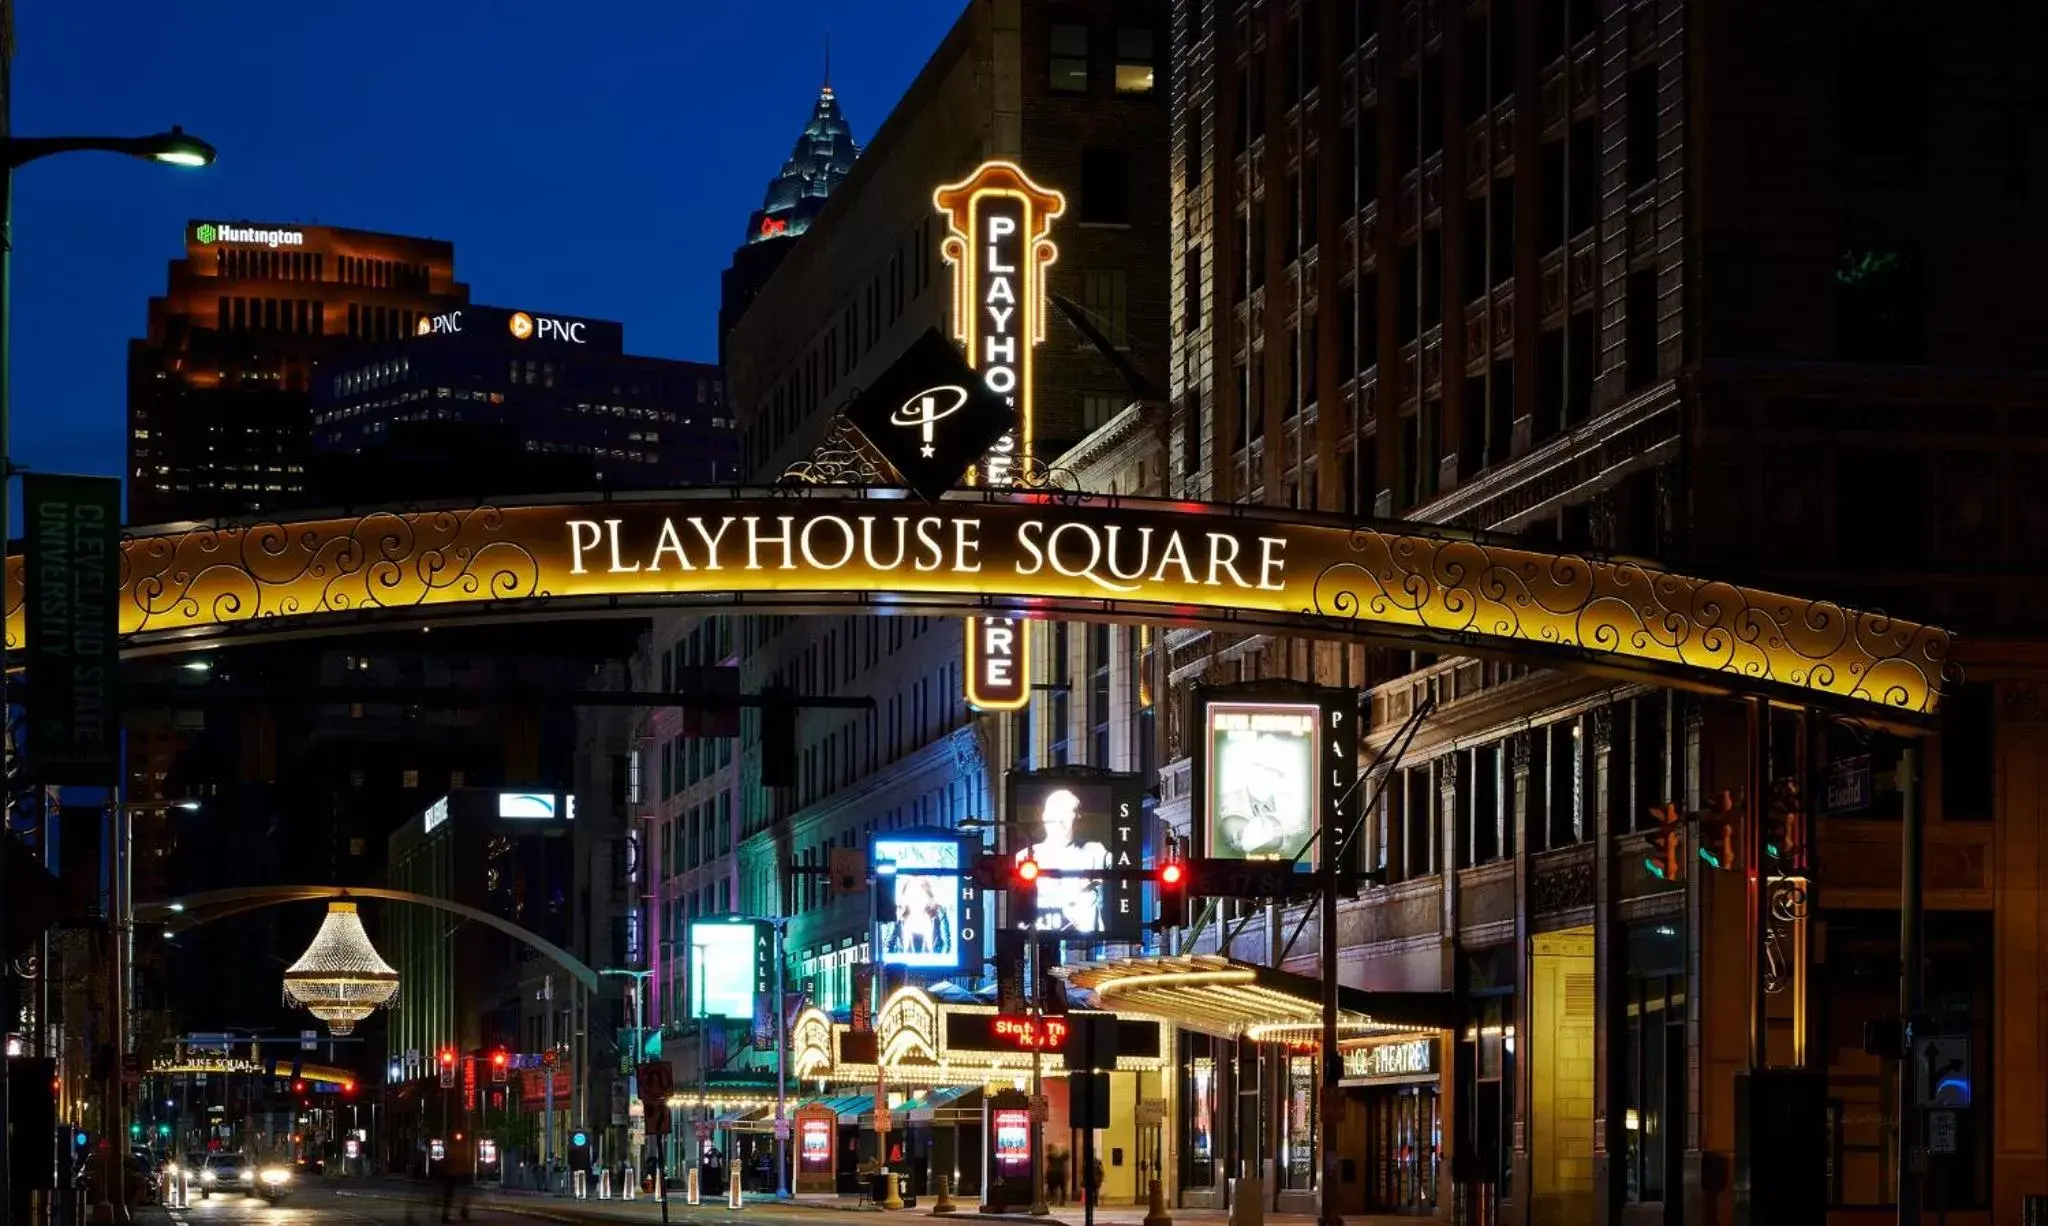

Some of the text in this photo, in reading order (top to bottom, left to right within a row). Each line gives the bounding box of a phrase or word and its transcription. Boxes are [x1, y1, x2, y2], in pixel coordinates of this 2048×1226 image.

[218, 225, 303, 248] Huntington
[432, 310, 462, 334] PNC
[536, 317, 586, 344] PNC
[984, 216, 1015, 484] PLAYHOSE
[38, 501, 69, 659] UNIVERSITY
[73, 503, 105, 655] CLEVELAND
[566, 514, 1287, 592] PLAYHOUSE SQUARE
[73, 663, 105, 743] STATE
[962, 875, 975, 941] HIO
[758, 936, 767, 992] ALLE
[152, 1058, 212, 1072] LAYOUSE
